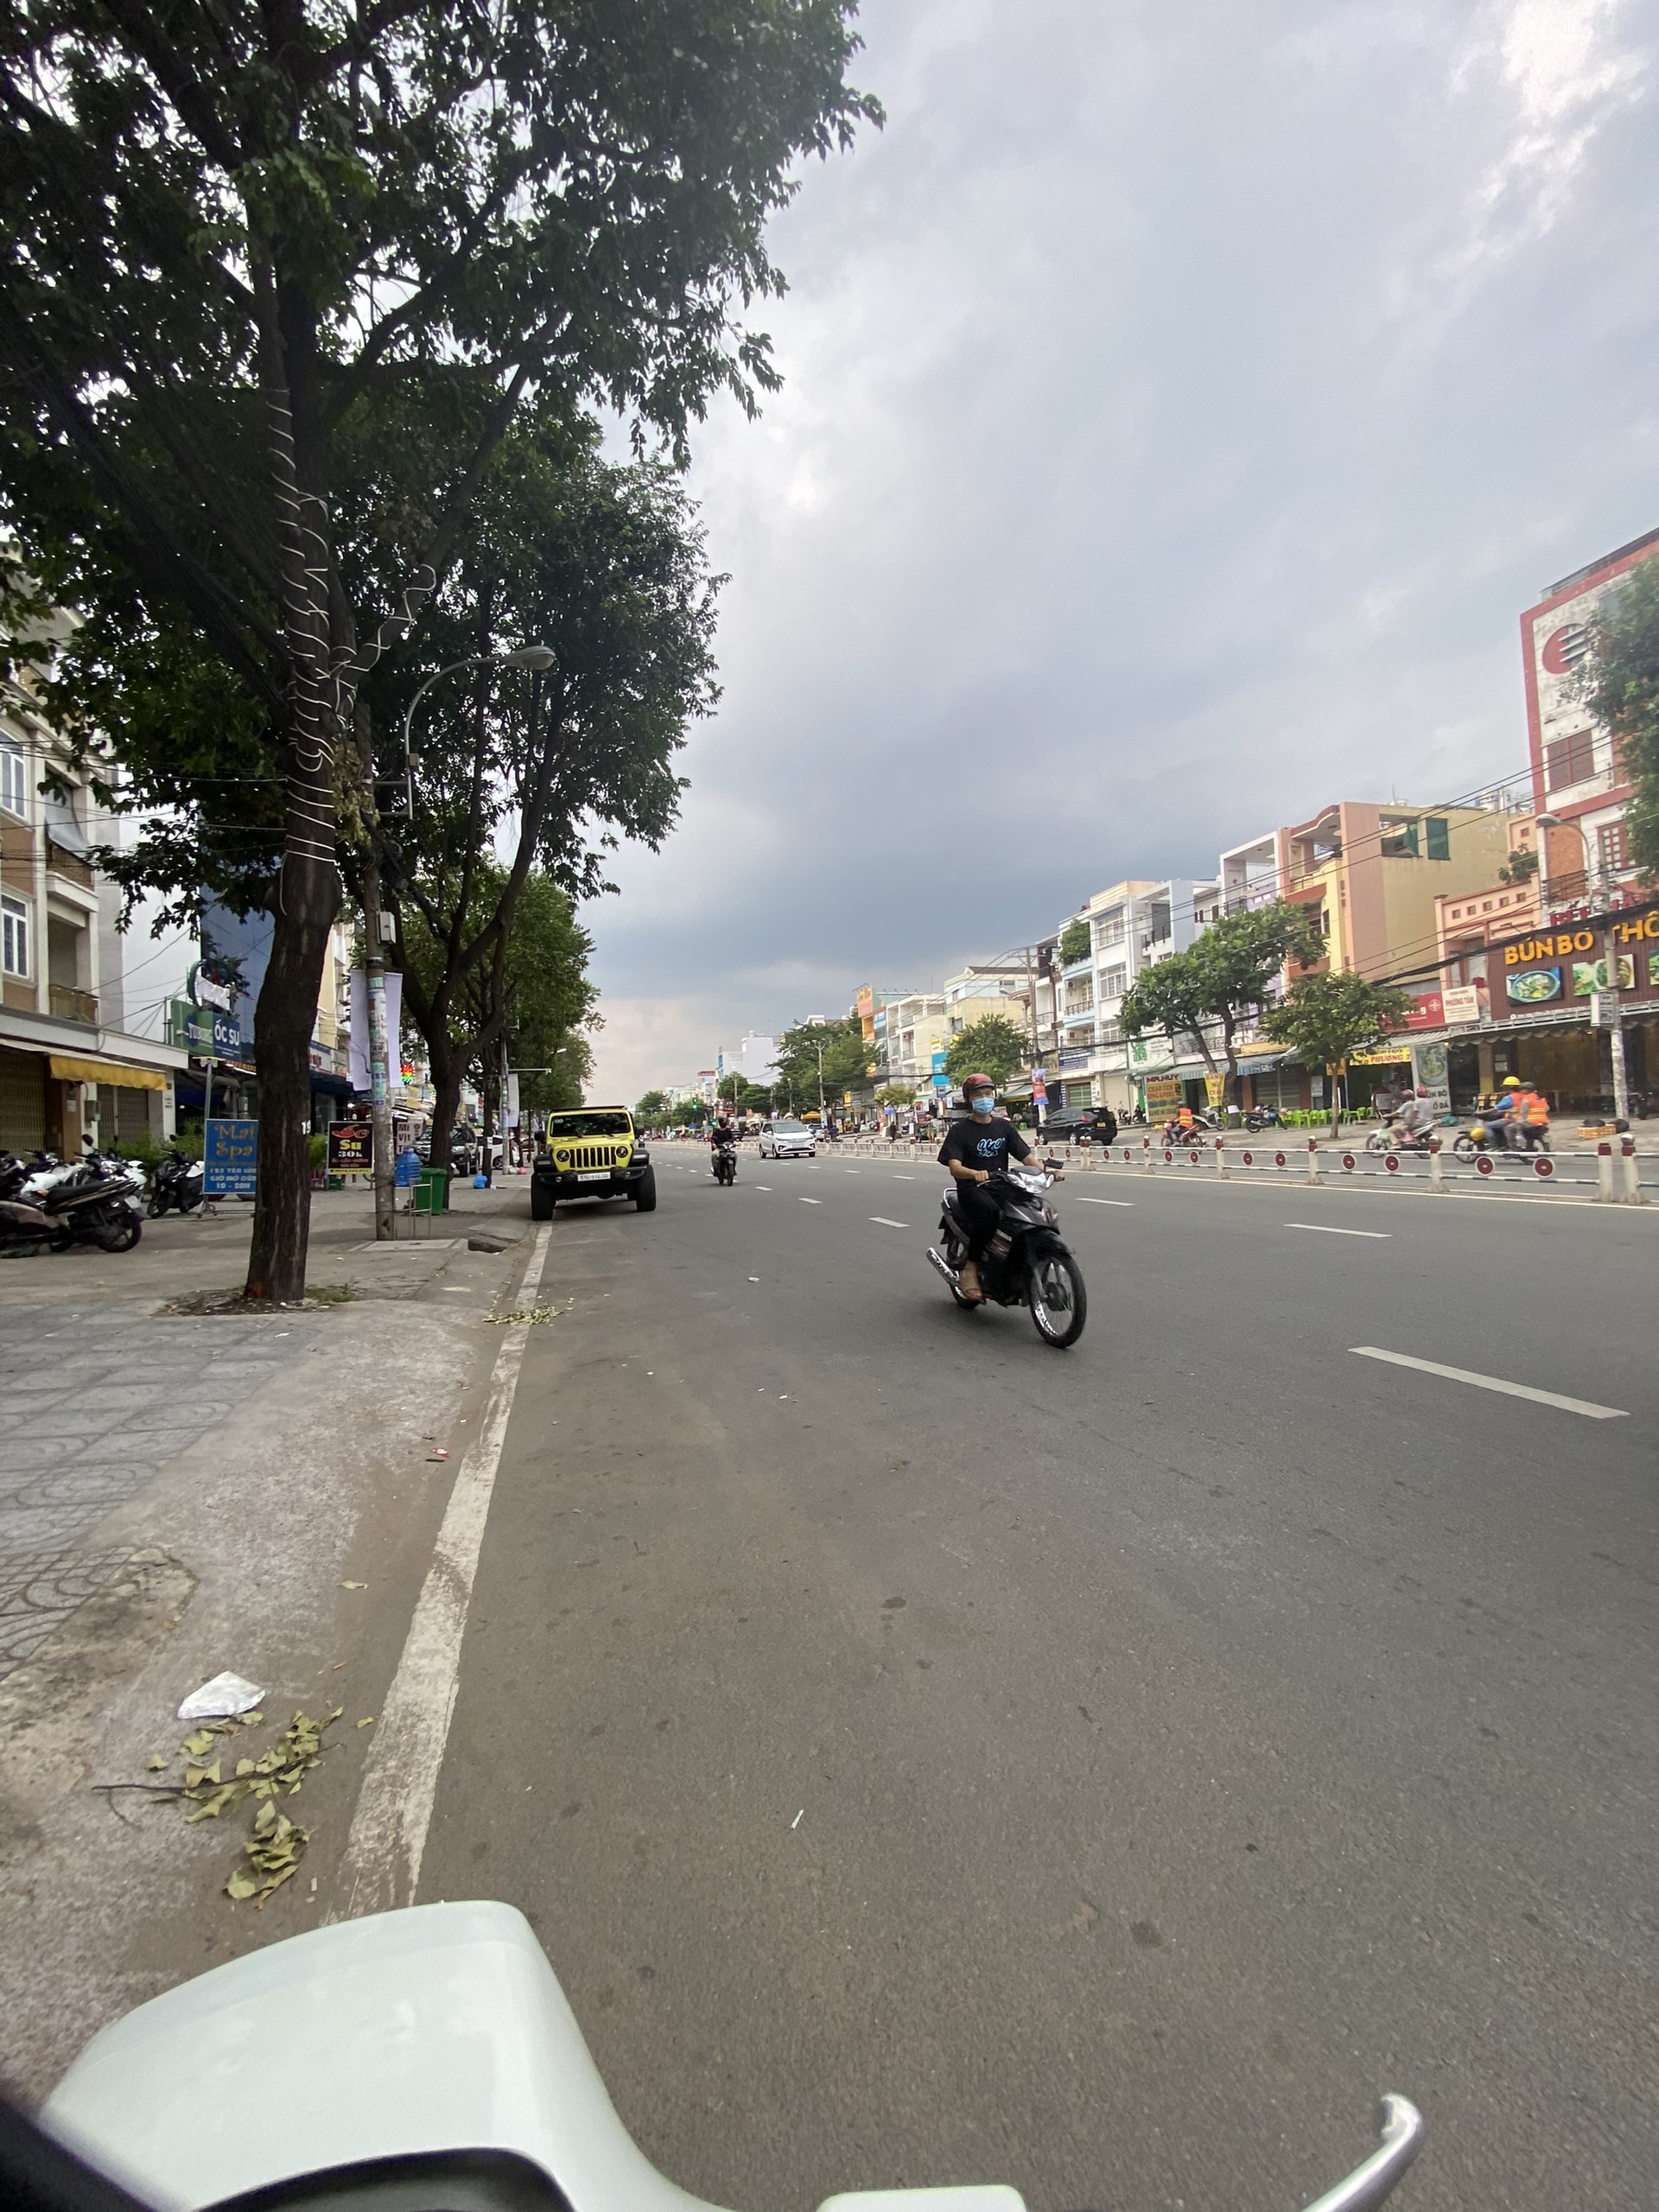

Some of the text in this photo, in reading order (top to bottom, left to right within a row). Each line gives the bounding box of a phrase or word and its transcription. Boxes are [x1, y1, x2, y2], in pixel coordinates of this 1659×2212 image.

[1504, 937, 1554, 965] BÚN
[214, 1019, 240, 1046] ỐC SU
[216, 1141, 253, 1160] Spa
[339, 1139, 362, 1150] Su
